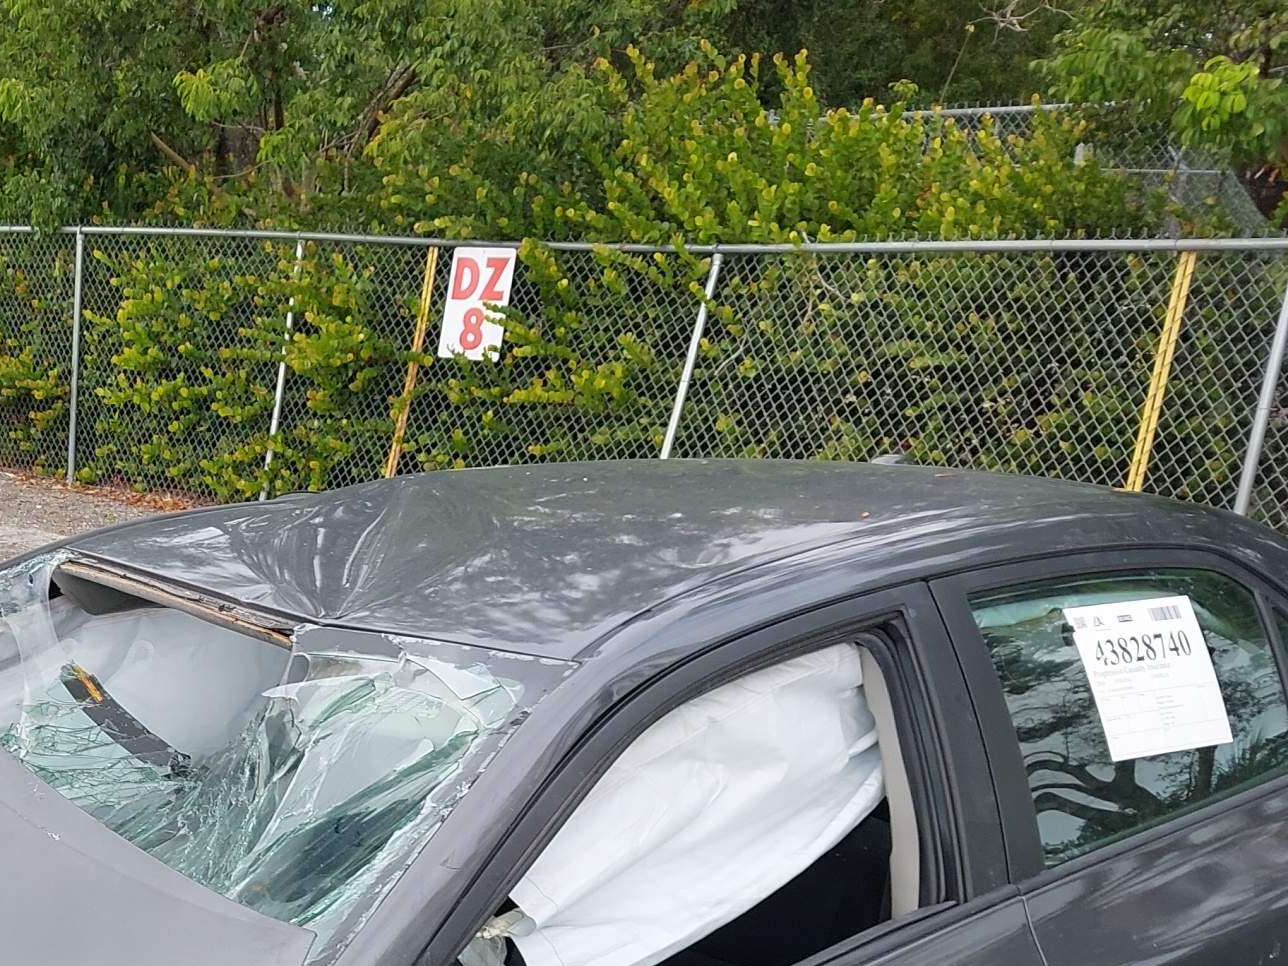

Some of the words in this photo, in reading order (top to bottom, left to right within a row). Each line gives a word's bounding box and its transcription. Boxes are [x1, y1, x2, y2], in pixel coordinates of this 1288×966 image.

[451, 256, 511, 301] DZ
[459, 307, 485, 350] 8
[1095, 629, 1192, 666] 43828740
